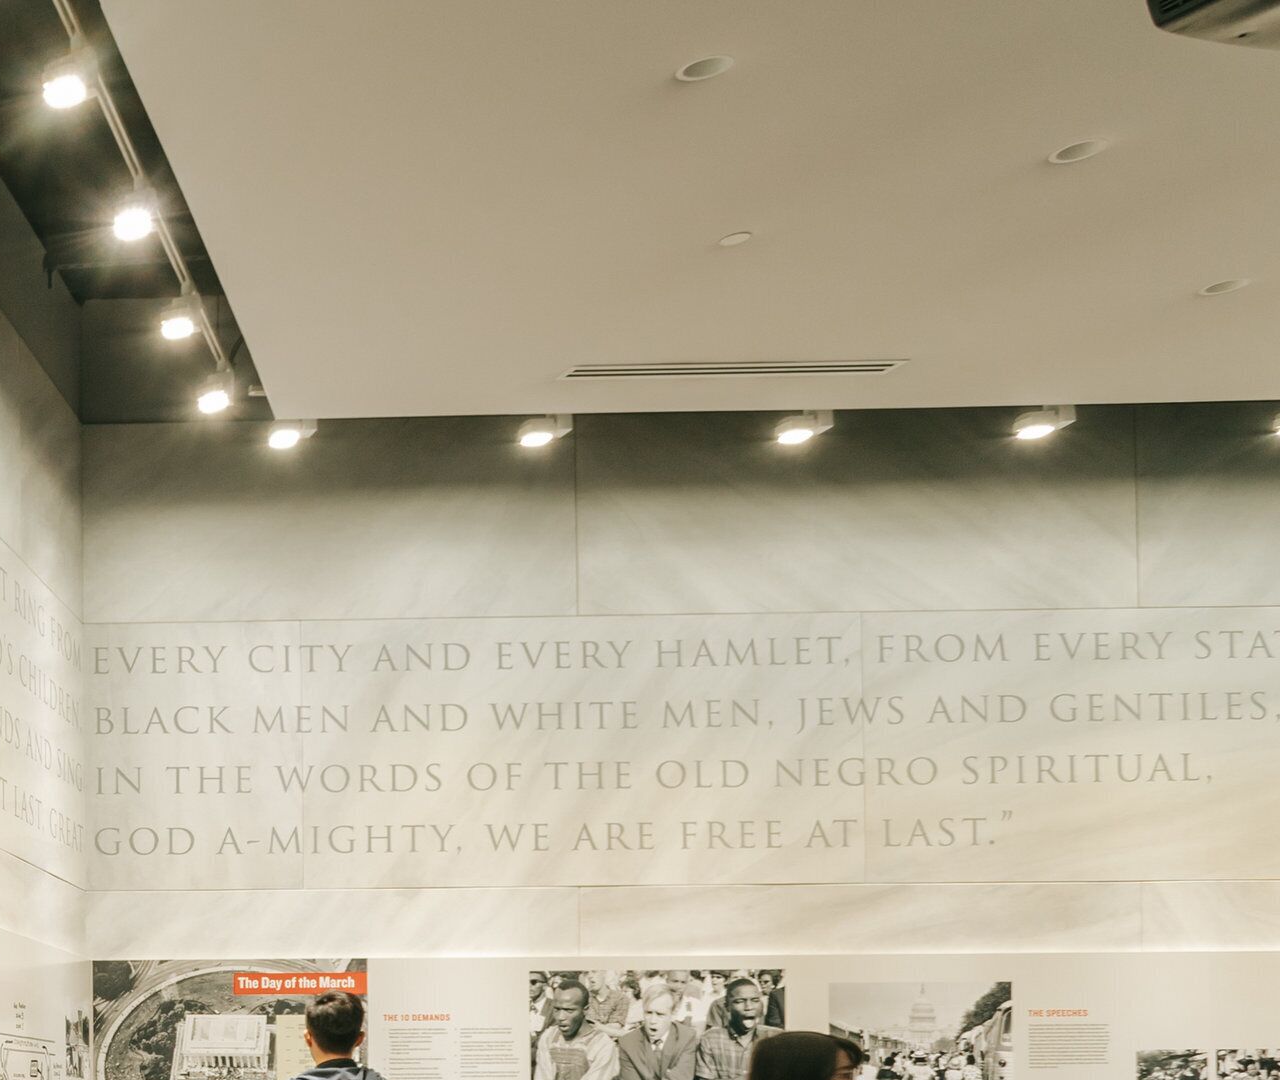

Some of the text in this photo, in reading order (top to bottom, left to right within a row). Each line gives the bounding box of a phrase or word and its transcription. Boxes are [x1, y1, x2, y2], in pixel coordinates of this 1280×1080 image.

[14, 580, 46, 637] RING
[50, 616, 81, 672] FROM
[93, 645, 228, 674] EVERY
[248, 643, 355, 674] CITY
[373, 641, 471, 672] AND
[496, 640, 633, 670] EVERY
[654, 636, 850, 668] HAMLET,
[876, 633, 1008, 664] FROM
[1034, 631, 1174, 662] EVERY
[94, 705, 235, 735] BLACK
[253, 703, 349, 734] MEN
[370, 702, 469, 732] AND
[488, 700, 639, 731] WHITE
[661, 698, 775, 730] MEN,
[796, 697, 905, 733] JEWS
[926, 695, 1027, 725] AND
[26, 727, 52, 770] AND
[97, 752, 1214, 795] IN THE WORDS OF THE OLD NEGRO SPIRITUAL,
[49, 808, 84, 853] GREAT
[93, 825, 195, 856] GOD
[215, 824, 463, 855] A-MIGHTY,
[484, 822, 550, 851] WE
[570, 821, 655, 851] ARE
[680, 820, 782, 850] FREE
[804, 818, 858, 848] AT
[238, 976, 355, 991] The Day of the March
[383, 1014, 399, 1022] THE
[412, 1013, 451, 1022] DEMANDS
[1028, 1009, 1089, 1017] THE SPEECHES
